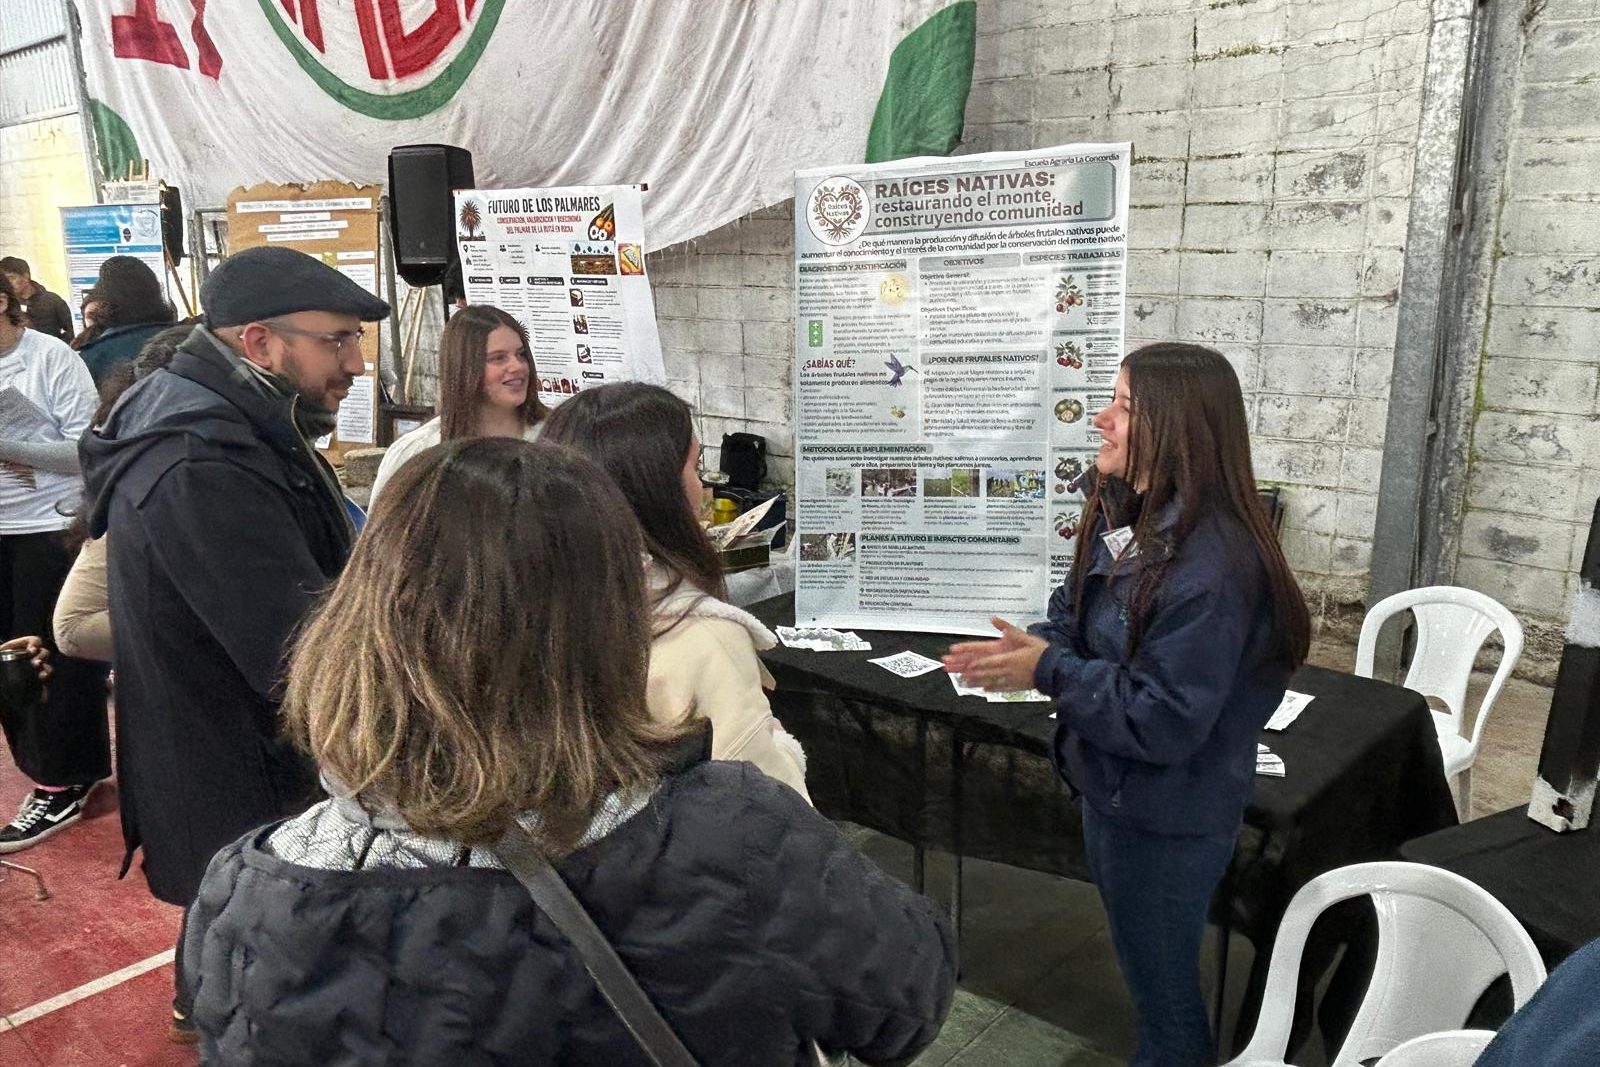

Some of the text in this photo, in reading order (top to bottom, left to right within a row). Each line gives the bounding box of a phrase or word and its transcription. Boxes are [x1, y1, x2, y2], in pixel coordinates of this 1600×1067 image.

[1024, 154, 1120, 168] Escuela Agraria La Concordia
[875, 171, 1055, 199] RAÍCES NATIVAS:
[488, 196, 600, 214] FUTURO DE LOS PALMARES
[875, 190, 1056, 213] restaurando el monte,
[875, 200, 1083, 230] construyendo comunidad
[859, 240, 872, 249] ¿De
[872, 239, 886, 249] qué
[887, 238, 914, 247] manera
[914, 237, 921, 245] la
[922, 235, 962, 248] producción
[968, 232, 997, 241] difusión
[1008, 230, 1035, 239] árboles
[1036, 228, 1065, 238] frutales
[1066, 227, 1095, 236] nativos
[1095, 225, 1120, 235] puede
[801, 251, 835, 259] aumentar
[843, 248, 889, 257] conocimiento
[889, 248, 895, 257] y
[896, 247, 902, 255] el
[902, 245, 927, 254] interés
[927, 244, 936, 253] de
[937, 244, 944, 252] la
[944, 241, 985, 251] comunidad
[986, 242, 998, 251] por
[1000, 240, 1007, 248] la
[1008, 238, 1056, 248] conservación
[1057, 236, 1069, 245] del
[1070, 236, 1097, 245] monte
[1098, 234, 1126, 243] nativo?
[944, 258, 984, 266] OBJETIVOS
[1029, 250, 1121, 262] ESPECIES TRABAJADAS
[800, 264, 847, 273] DIAGNÓSTICO
[855, 262, 907, 271] JUSTIFICACIÓN
[802, 356, 856, 371] ¿SABÍAS QUÉ?
[928, 356, 947, 364] ¿POR
[965, 355, 1002, 363] FRUTALES
[967, 536, 1020, 544] COMUNITARIO
